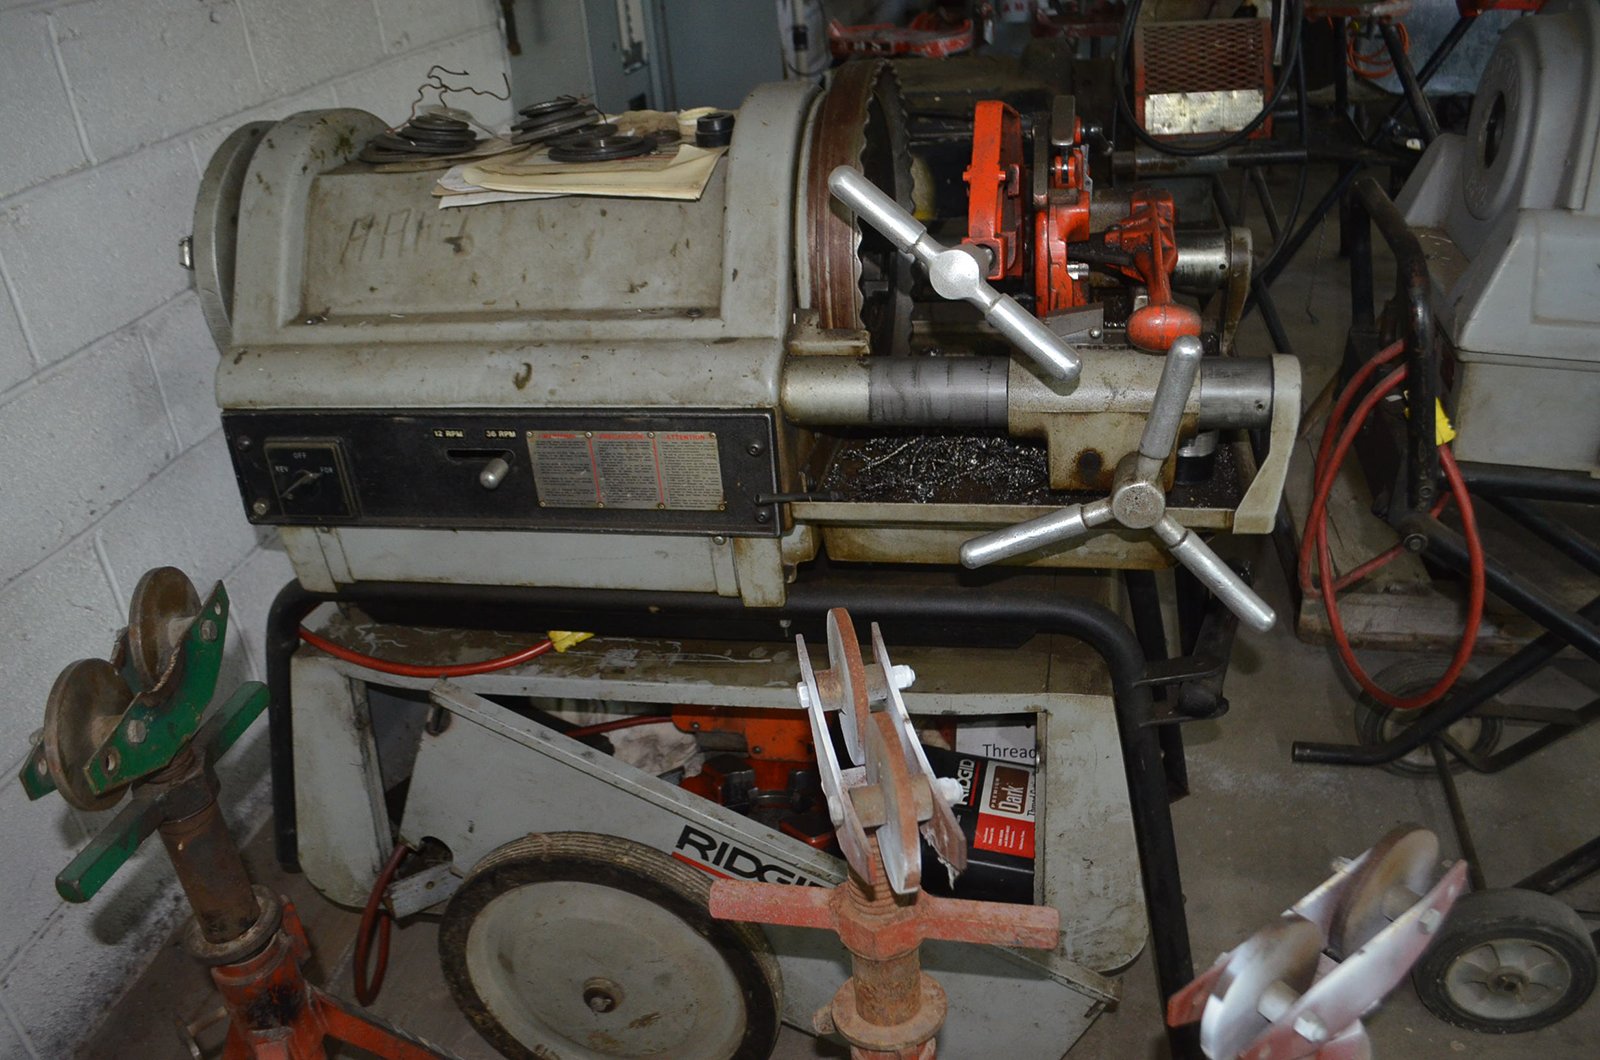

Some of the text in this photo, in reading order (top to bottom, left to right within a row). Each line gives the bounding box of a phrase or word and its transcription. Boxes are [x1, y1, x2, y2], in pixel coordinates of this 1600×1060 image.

[498, 430, 516, 438] RPM
[666, 433, 706, 441] ATTENTION
[998, 785, 1024, 812] Dark
[676, 825, 825, 888] RIDG
